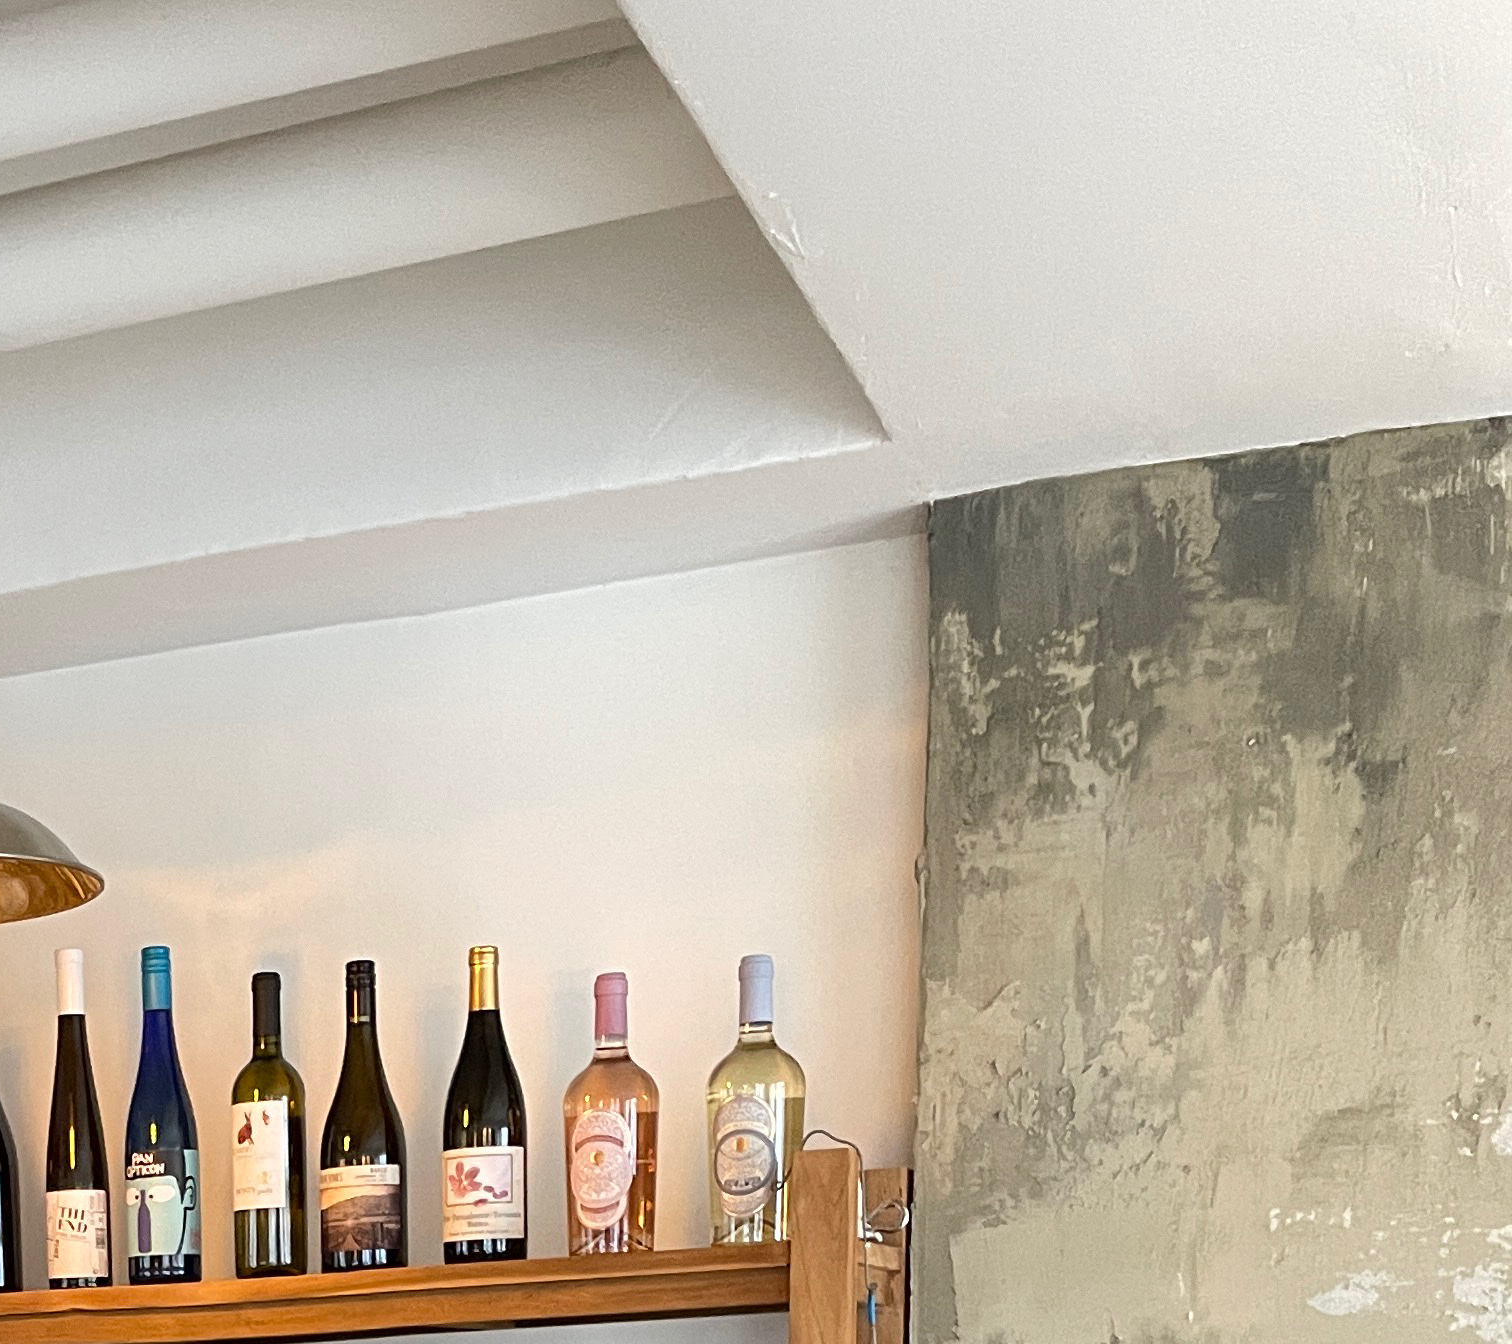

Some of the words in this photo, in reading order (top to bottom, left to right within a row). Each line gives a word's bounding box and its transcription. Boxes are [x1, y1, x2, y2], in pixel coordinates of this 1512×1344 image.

[131, 1152, 154, 1167] PAN
[60, 1207, 85, 1220] THE
[57, 1219, 88, 1233] END
